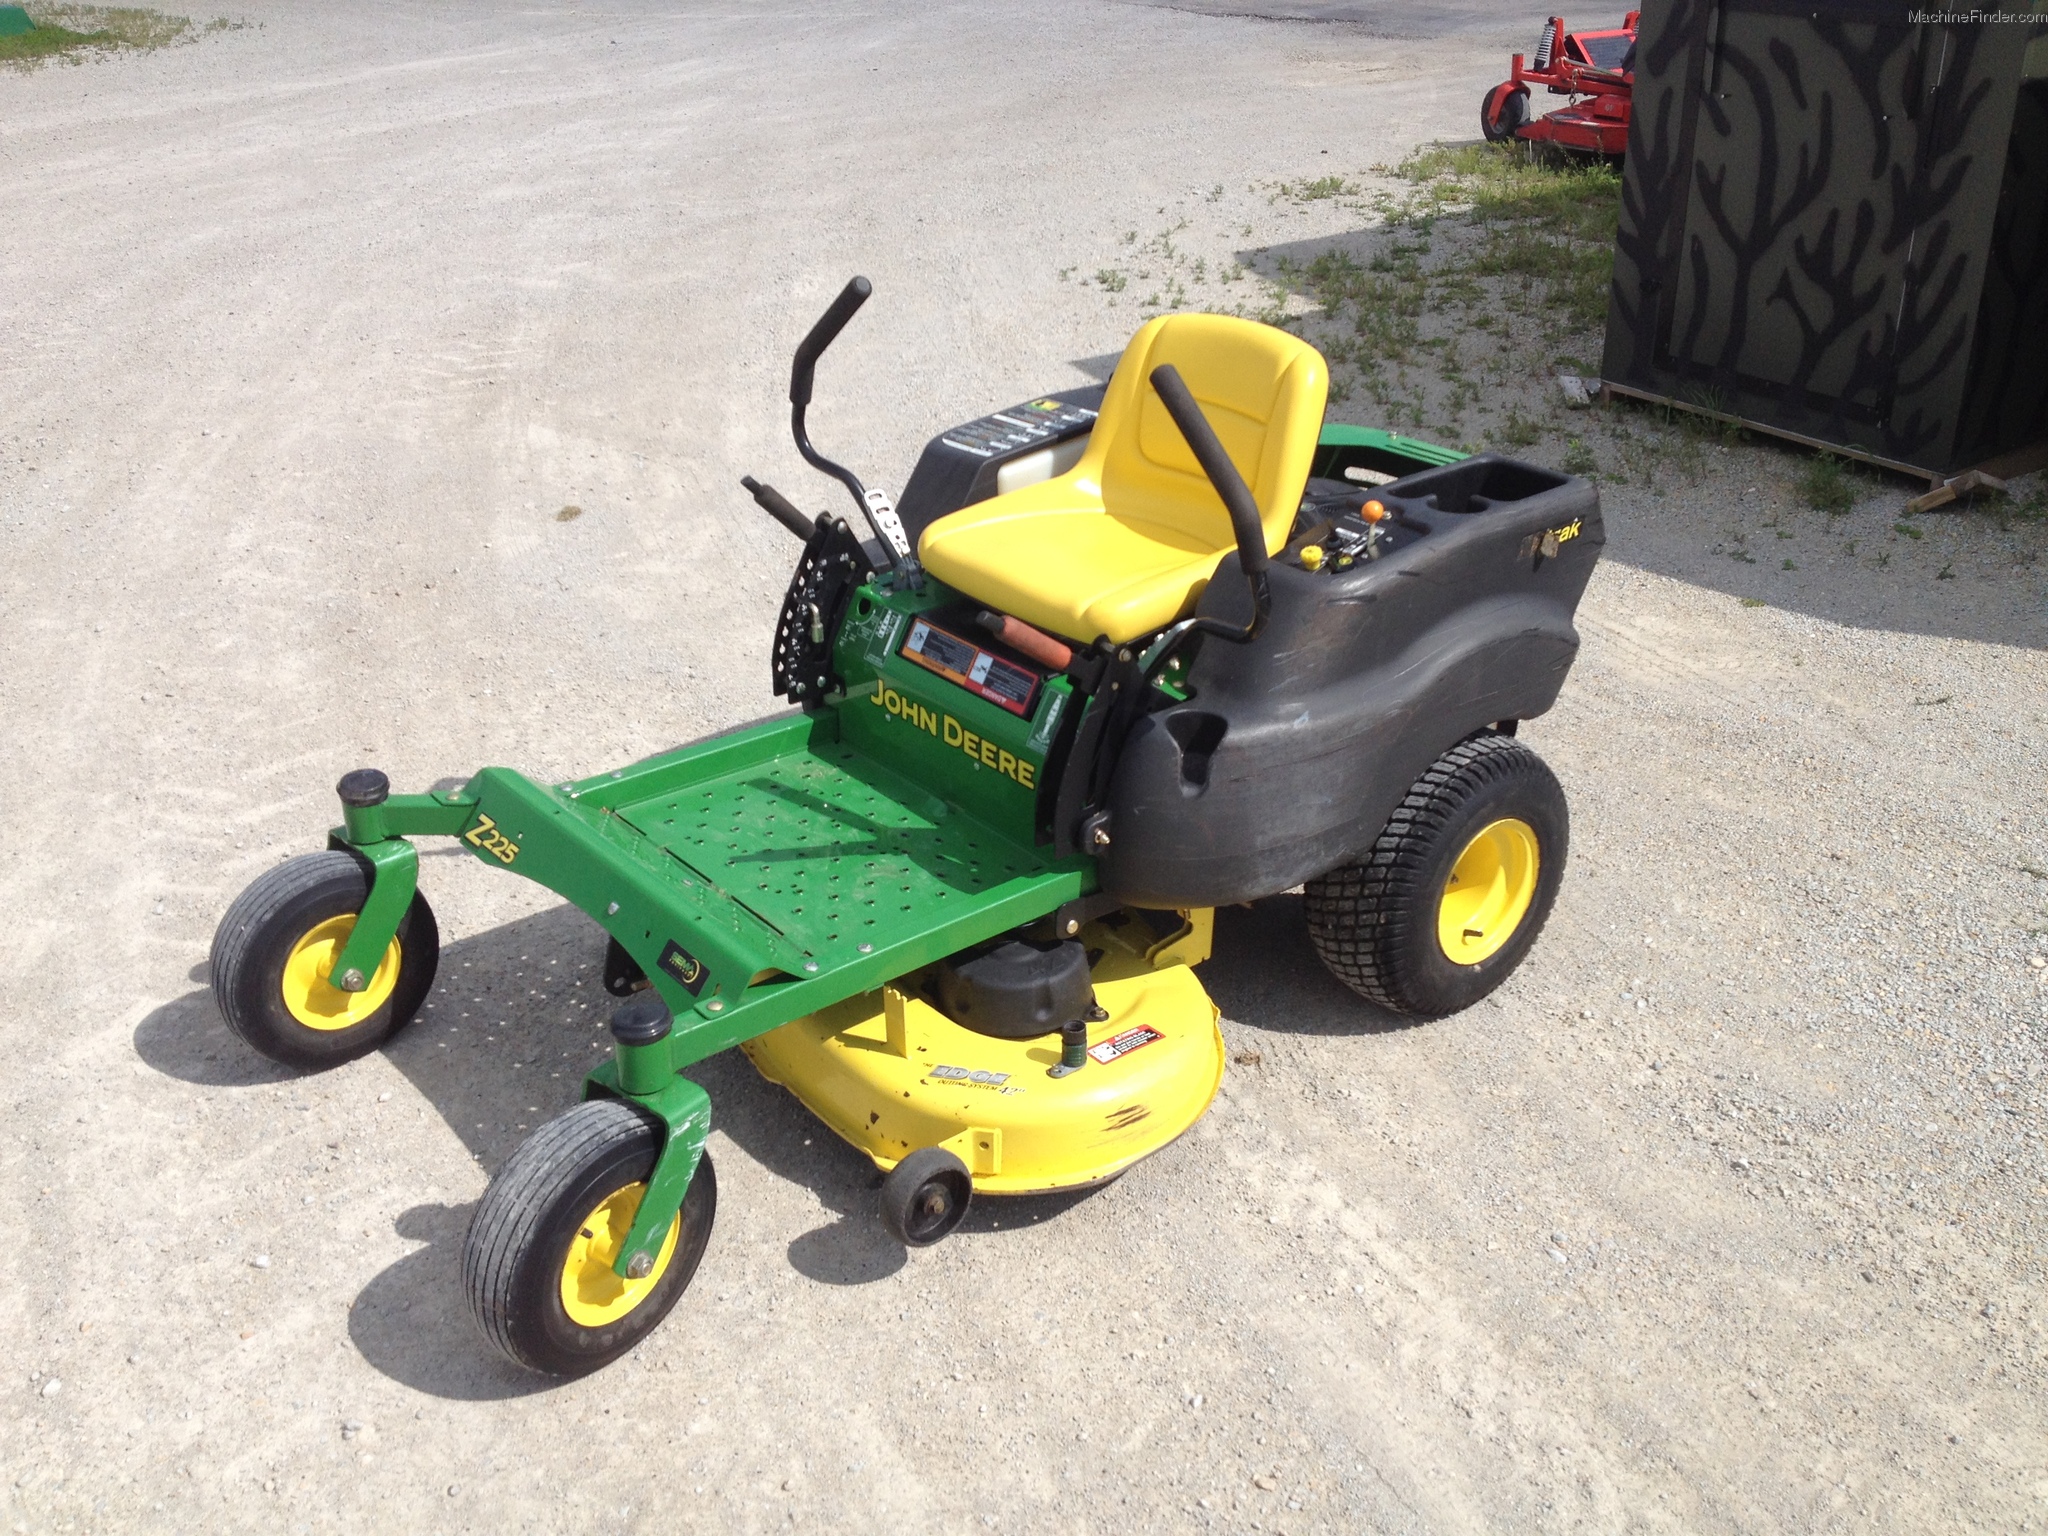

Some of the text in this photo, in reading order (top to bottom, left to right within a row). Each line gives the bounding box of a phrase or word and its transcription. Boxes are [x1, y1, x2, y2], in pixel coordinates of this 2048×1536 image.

[870, 679, 937, 737] JOHN
[943, 714, 1035, 790] DEERE
[464, 813, 520, 864] Z225
[928, 1064, 1012, 1086] EDGE
